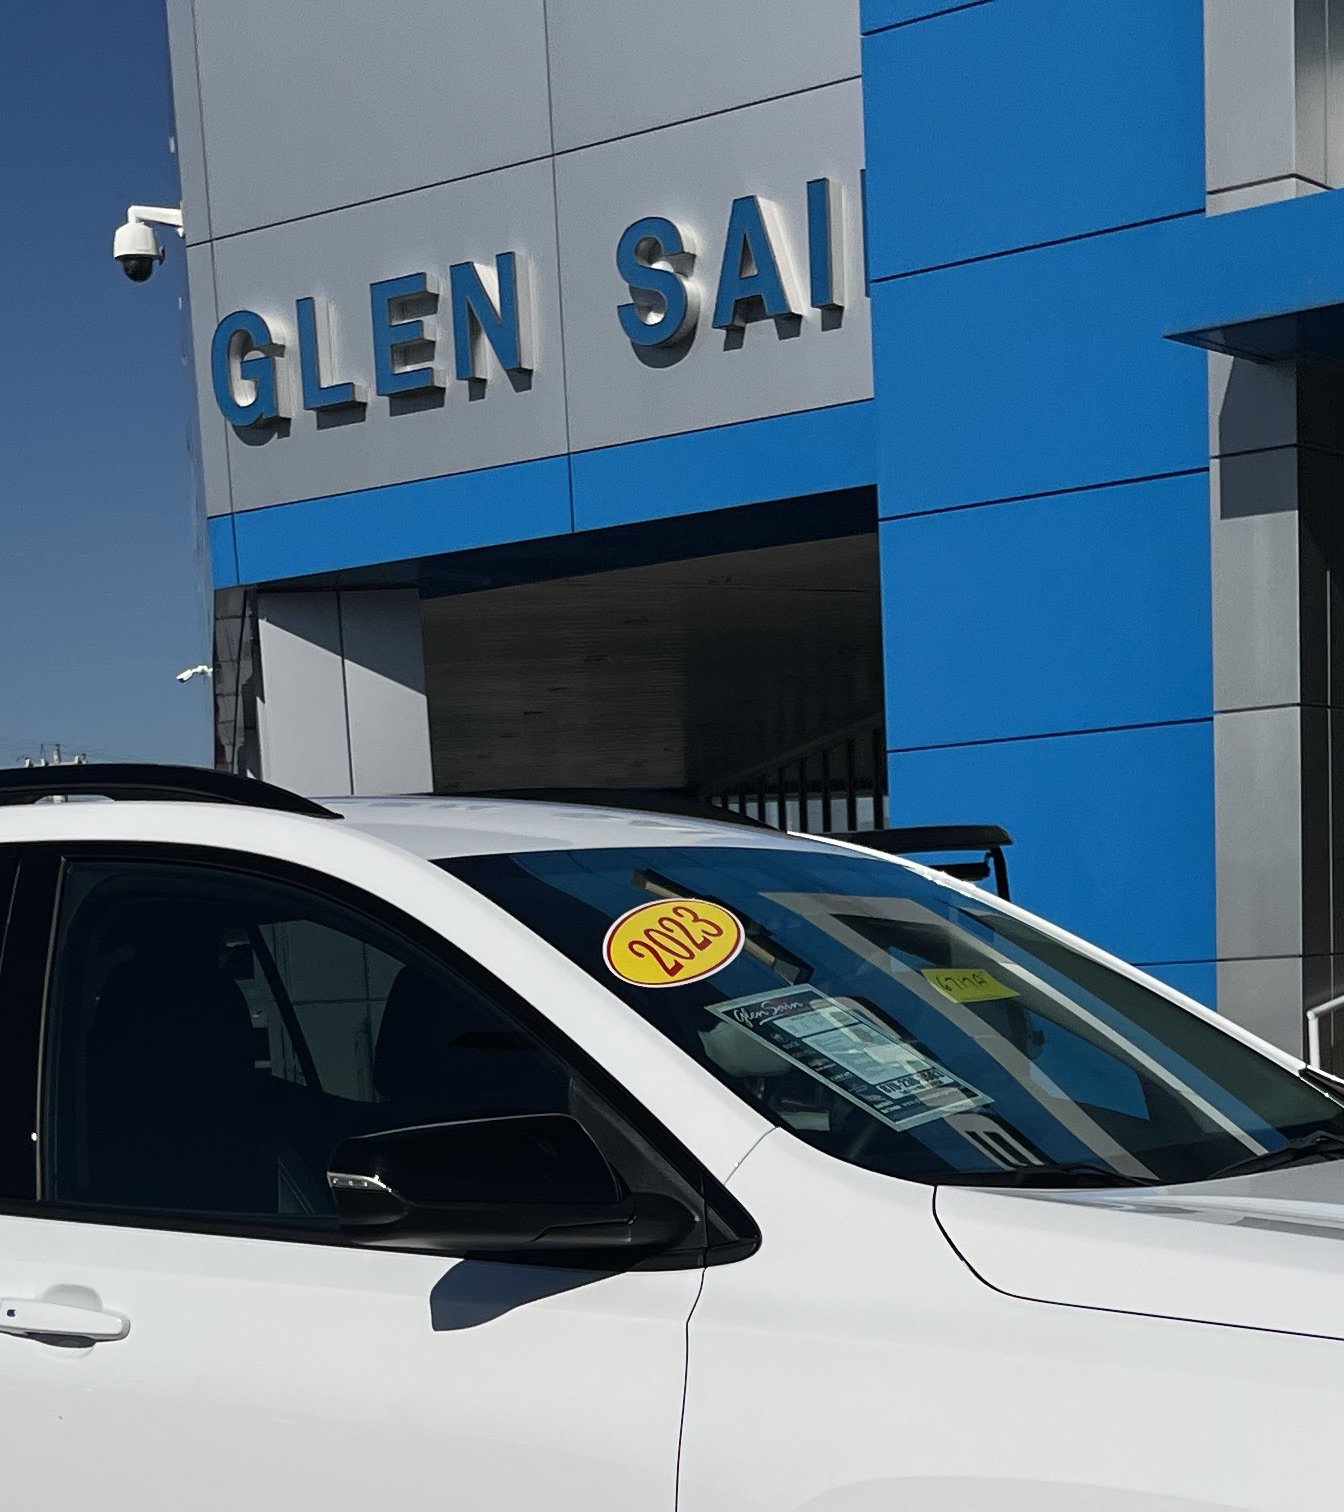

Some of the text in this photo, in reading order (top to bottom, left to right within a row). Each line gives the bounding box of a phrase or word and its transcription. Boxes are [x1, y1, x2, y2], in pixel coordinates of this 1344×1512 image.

[211, 168, 870, 427] GLEN SAI
[627, 906, 724, 977] 2023
